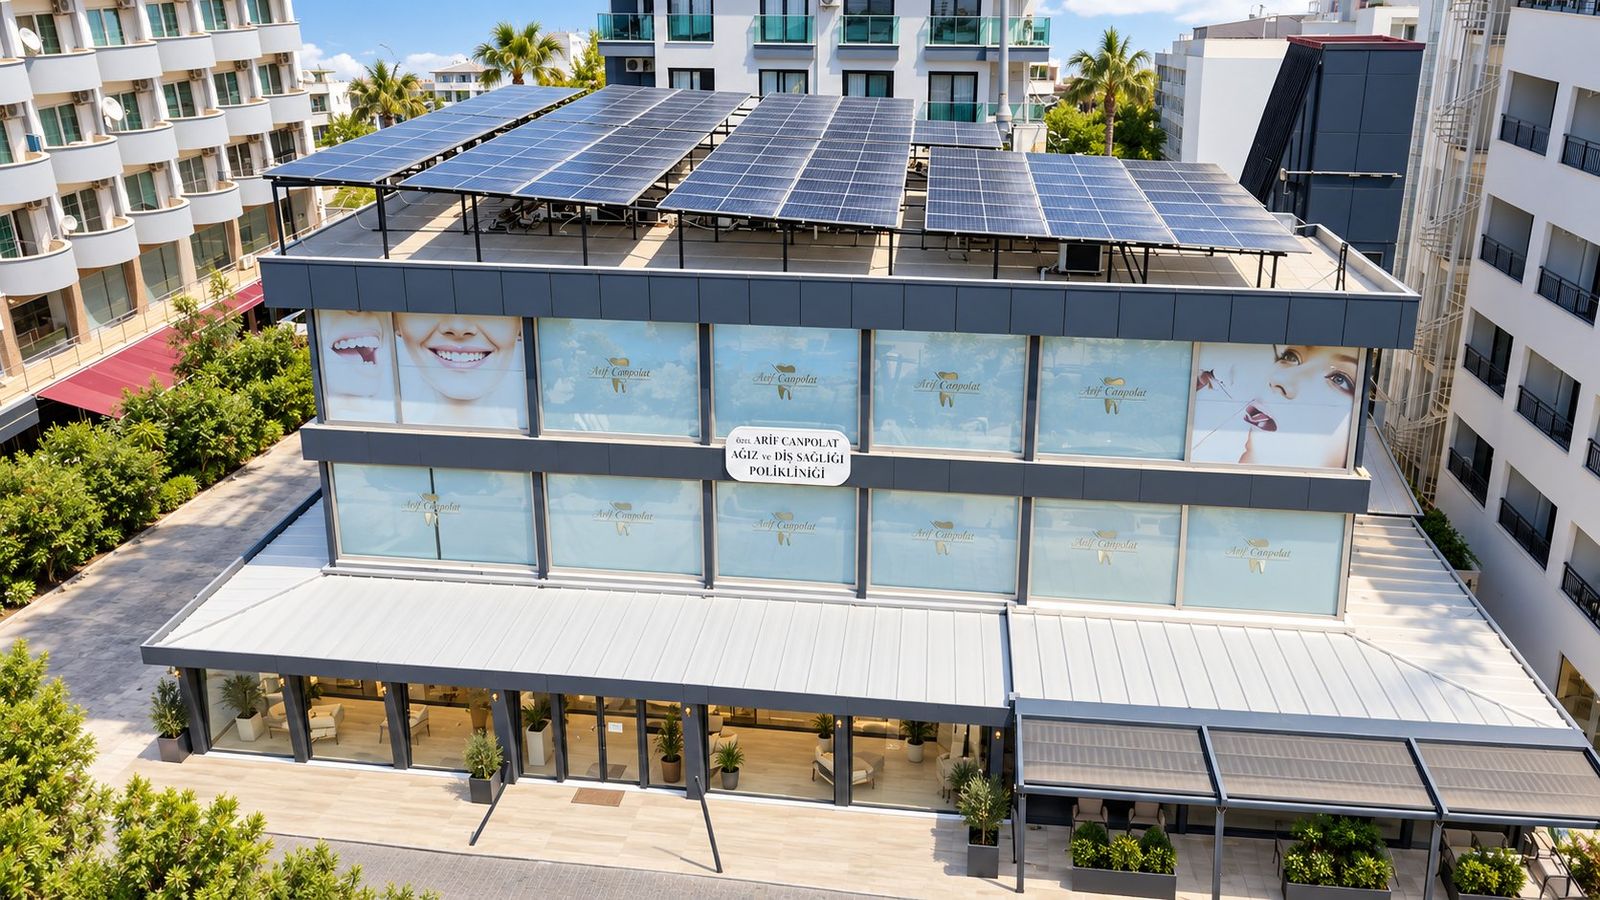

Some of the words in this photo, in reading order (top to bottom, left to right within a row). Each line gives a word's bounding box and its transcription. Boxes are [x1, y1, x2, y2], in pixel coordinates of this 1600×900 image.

[752, 372, 776, 383] Arif
[777, 374, 818, 386] Canpolat
[914, 379, 938, 390] Arif
[939, 380, 980, 392] Canpolat
[1079, 385, 1102, 397] Arif
[1105, 386, 1147, 398] Canpolat
[754, 434, 780, 446] ARİF
[781, 436, 839, 448] CANPOLAT
[731, 447, 758, 460] AĞIZ
[774, 449, 793, 464] DİŞ
